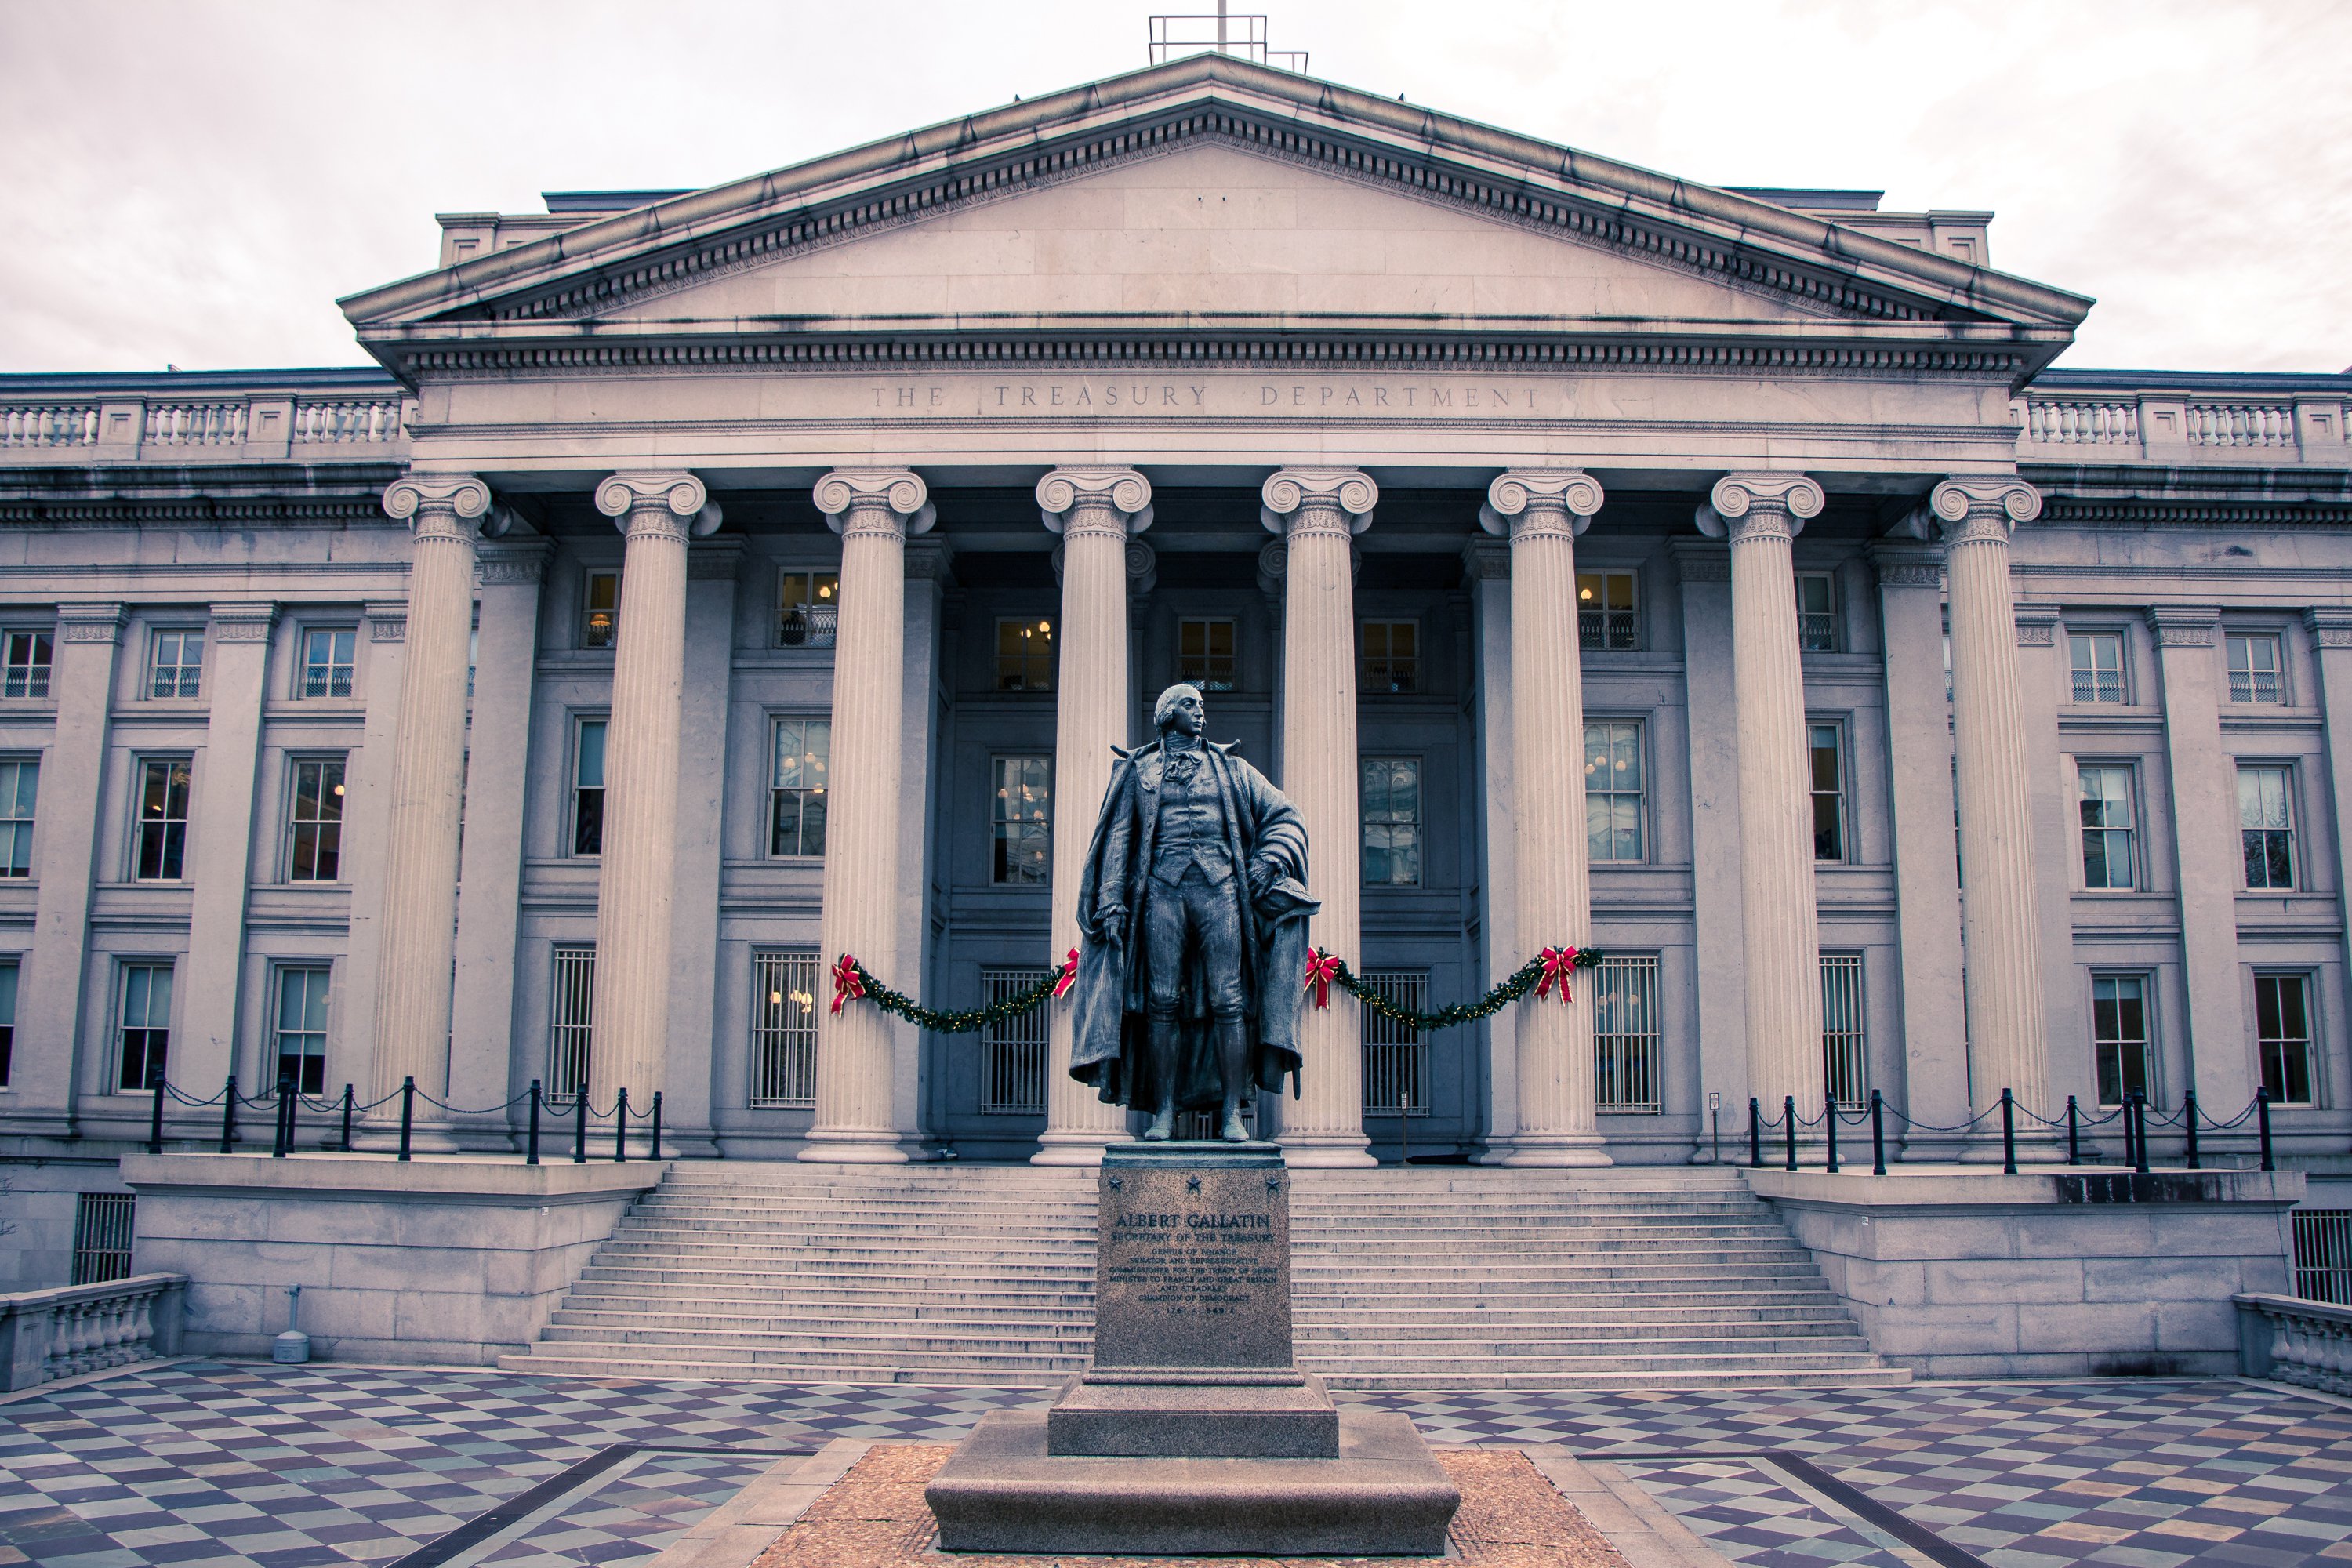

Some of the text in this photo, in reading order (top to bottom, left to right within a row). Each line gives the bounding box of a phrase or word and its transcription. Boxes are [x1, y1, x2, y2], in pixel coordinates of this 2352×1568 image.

[871, 386, 1538, 408] THE TREASURY DEPARTMENT
[1116, 1214, 1270, 1229] ALBERT GALLATIN
[1111, 1232, 1171, 1241] SECRETARY
[1195, 1233, 1216, 1242] THE
[1221, 1233, 1276, 1243] TREASURY
